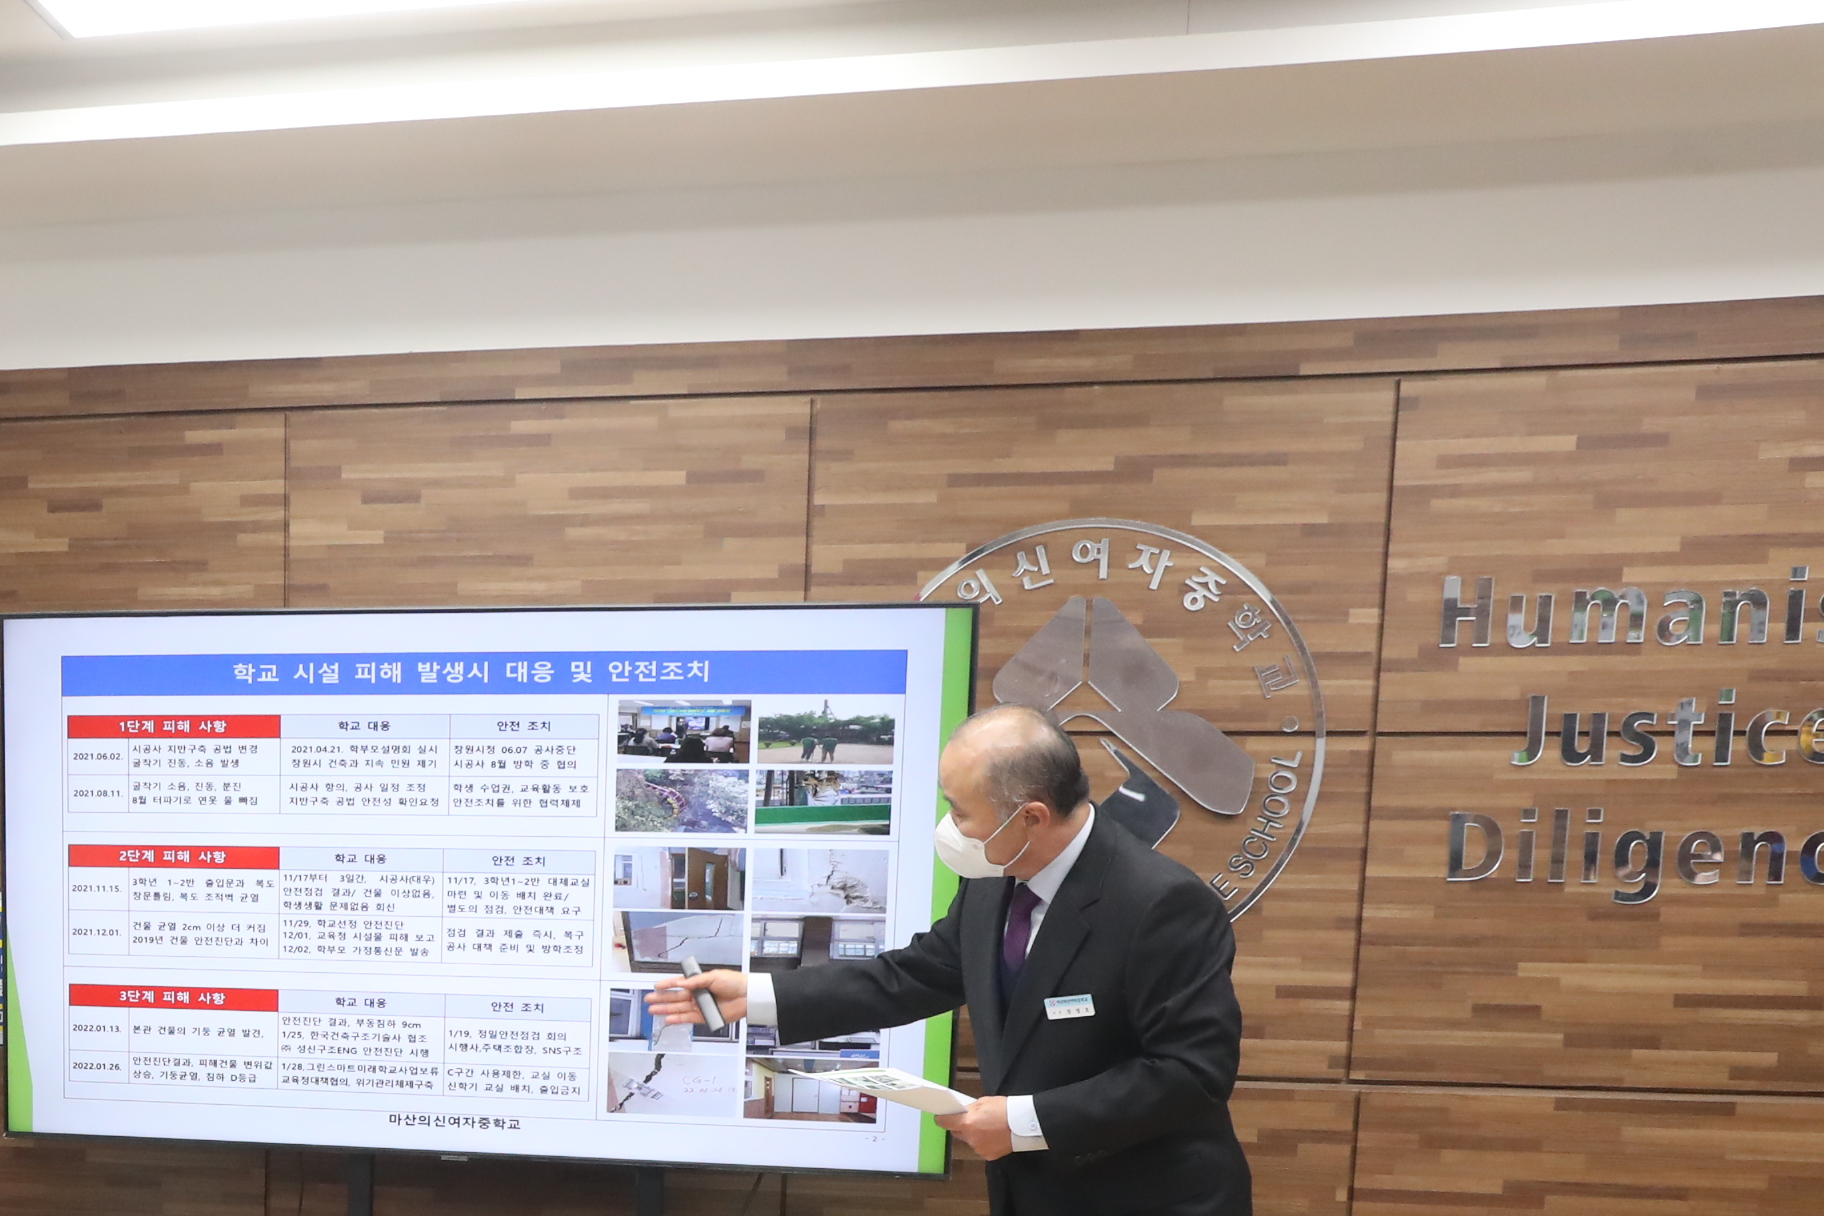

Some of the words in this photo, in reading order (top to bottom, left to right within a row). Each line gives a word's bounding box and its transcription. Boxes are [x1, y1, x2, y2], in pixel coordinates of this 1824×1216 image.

[1439, 566, 1824, 649] Humani
[232, 663, 279, 684] 학교
[293, 662, 339, 684] 시설
[354, 661, 402, 683] 피해
[417, 661, 488, 683] 발생시
[505, 660, 554, 683] 대응
[570, 660, 592, 683] 및
[608, 660, 709, 682] 안전조치
[119, 719, 154, 733] 1단계
[198, 720, 227, 733] 사항
[1229, 750, 1303, 879] SCHOOL
[119, 849, 154, 862] 2단계
[198, 850, 226, 863] 사항
[119, 989, 154, 1003] 3단계
[197, 992, 226, 1005] 사항
